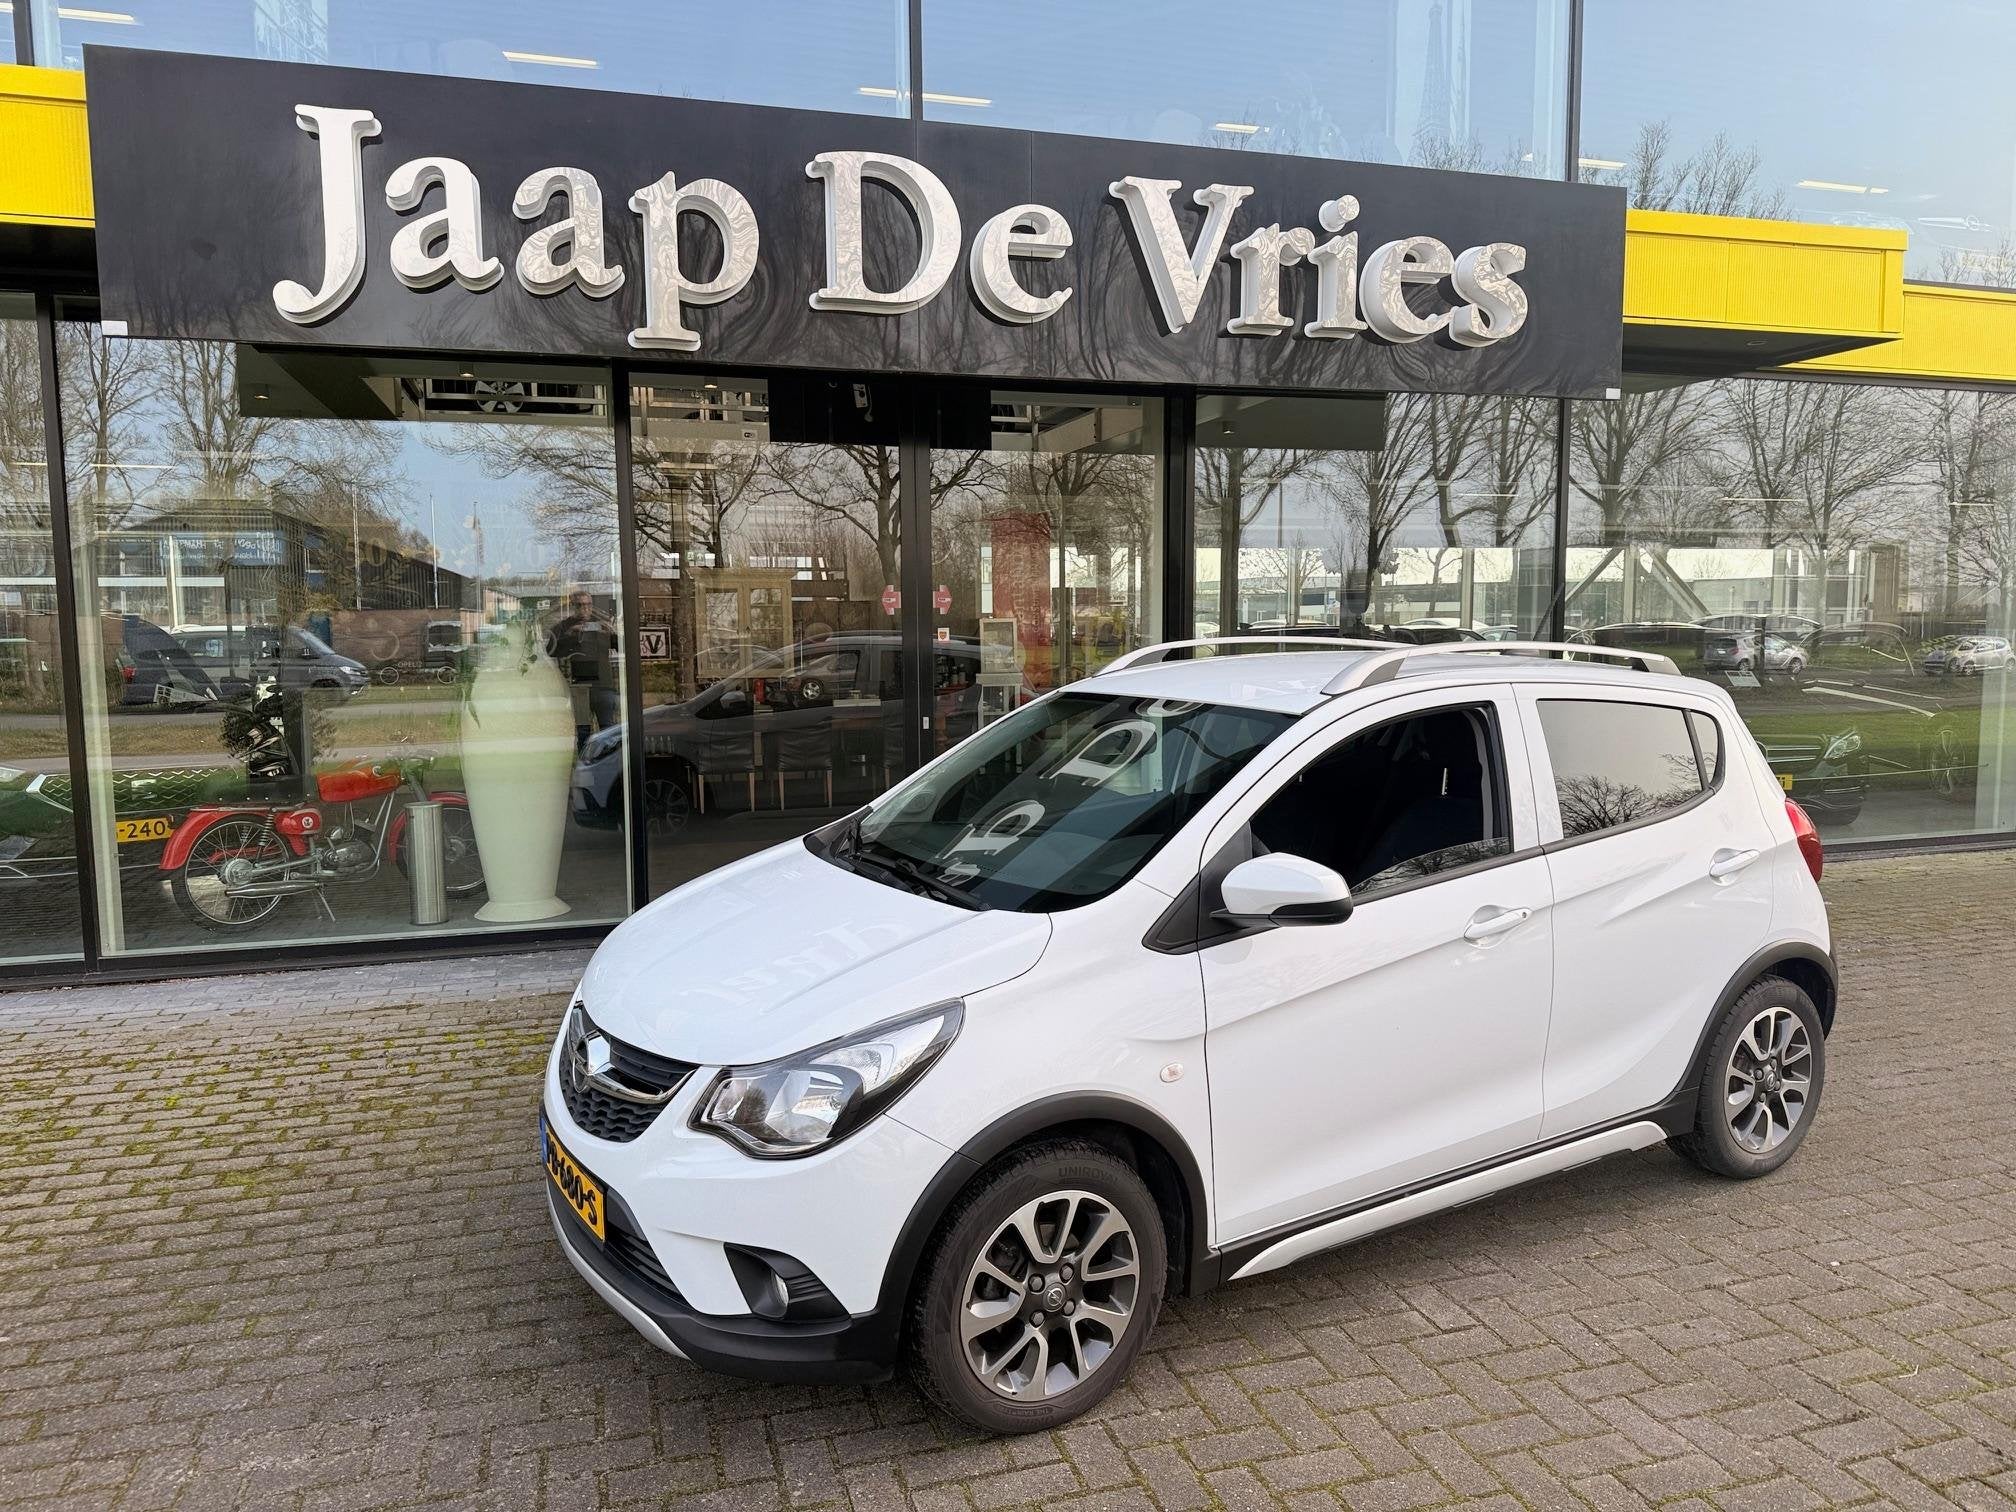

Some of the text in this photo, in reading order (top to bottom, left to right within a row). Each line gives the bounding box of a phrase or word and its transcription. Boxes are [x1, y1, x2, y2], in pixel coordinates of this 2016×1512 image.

[273, 104, 1529, 351] Jaap De Vries
